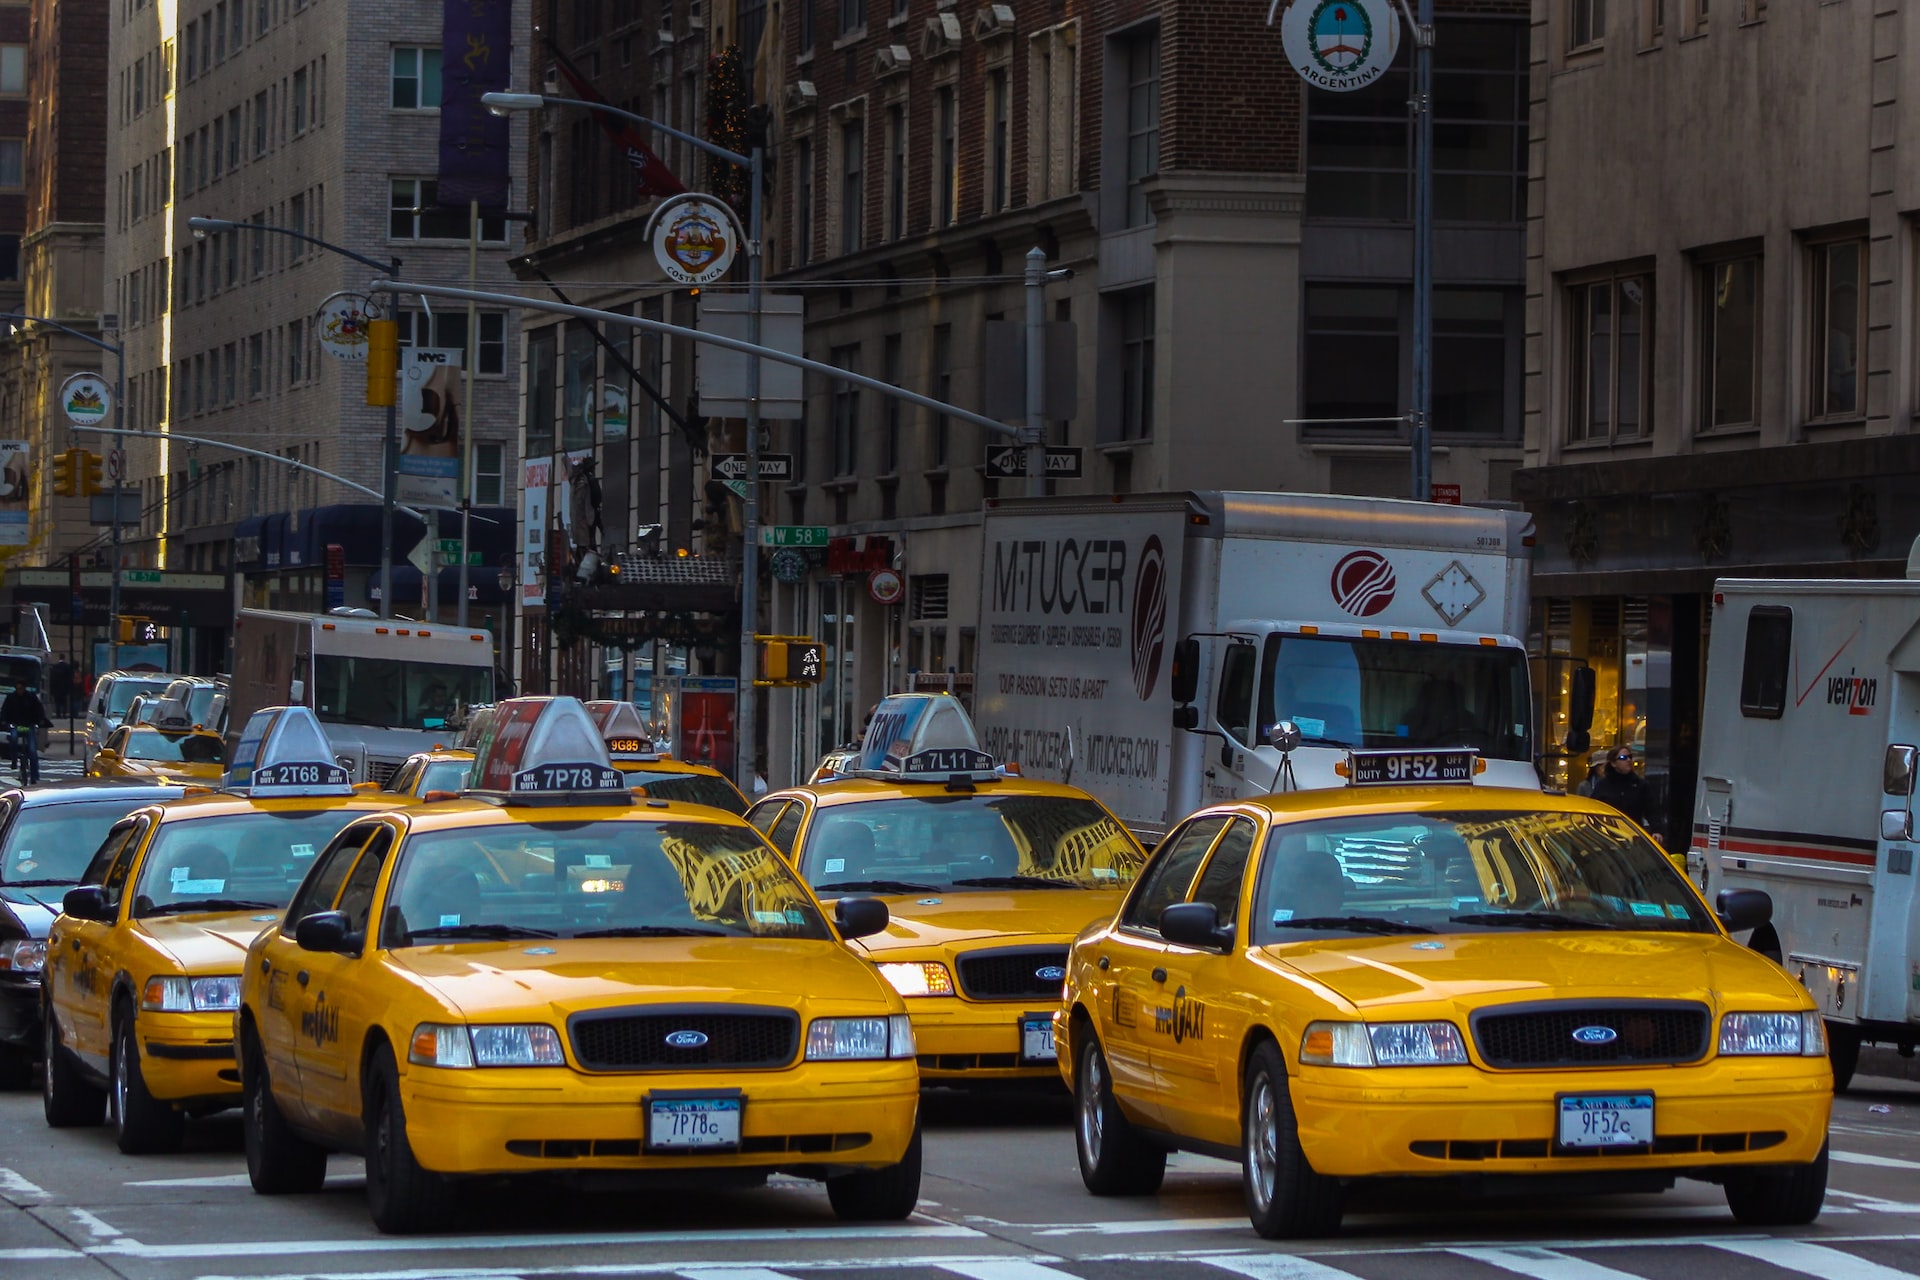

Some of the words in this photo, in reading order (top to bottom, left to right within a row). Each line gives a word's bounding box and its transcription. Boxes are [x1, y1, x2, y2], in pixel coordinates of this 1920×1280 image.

[1300, 65, 1381, 88] ARGENTINA
[666, 265, 697, 282] COSTA
[701, 267, 723, 282] RICA
[332, 350, 363, 359] CHILE
[417, 352, 446, 363] NYC
[1001, 455, 1026, 468] ONE
[723, 462, 746, 473] ONE
[758, 462, 781, 473] WAY
[775, 528, 787, 543] W
[795, 528, 813, 544] 58
[817, 529, 826, 537] ST
[1016, 674, 1046, 697] PASSION
[1048, 676, 1067, 697] SETS
[1069, 677, 1081, 698] US
[1827, 667, 1877, 716] verizon
[867, 713, 907, 752] TOKYO
[611, 739, 639, 751] 9G85
[928, 751, 967, 769] 7L11
[1360, 756, 1377, 767] OFF
[1445, 755, 1463, 765] OFF
[909, 763, 924, 771] DUTY
[974, 762, 990, 770] DUTY
[1386, 756, 1438, 780] 9F52
[279, 766, 319, 783] 2T68
[329, 769, 340, 777] OFF
[522, 773, 536, 782] OFF
[601, 771, 615, 780] OFF
[1356, 769, 1381, 780] DUTY
[1442, 767, 1468, 778] DUTY
[543, 768, 593, 789] 7P78
[599, 779, 618, 787] DUTY
[520, 781, 539, 790] DUTY
[1043, 968, 1063, 978] Ford
[676, 1033, 699, 1044] Ford
[1583, 1029, 1606, 1040] Ford
